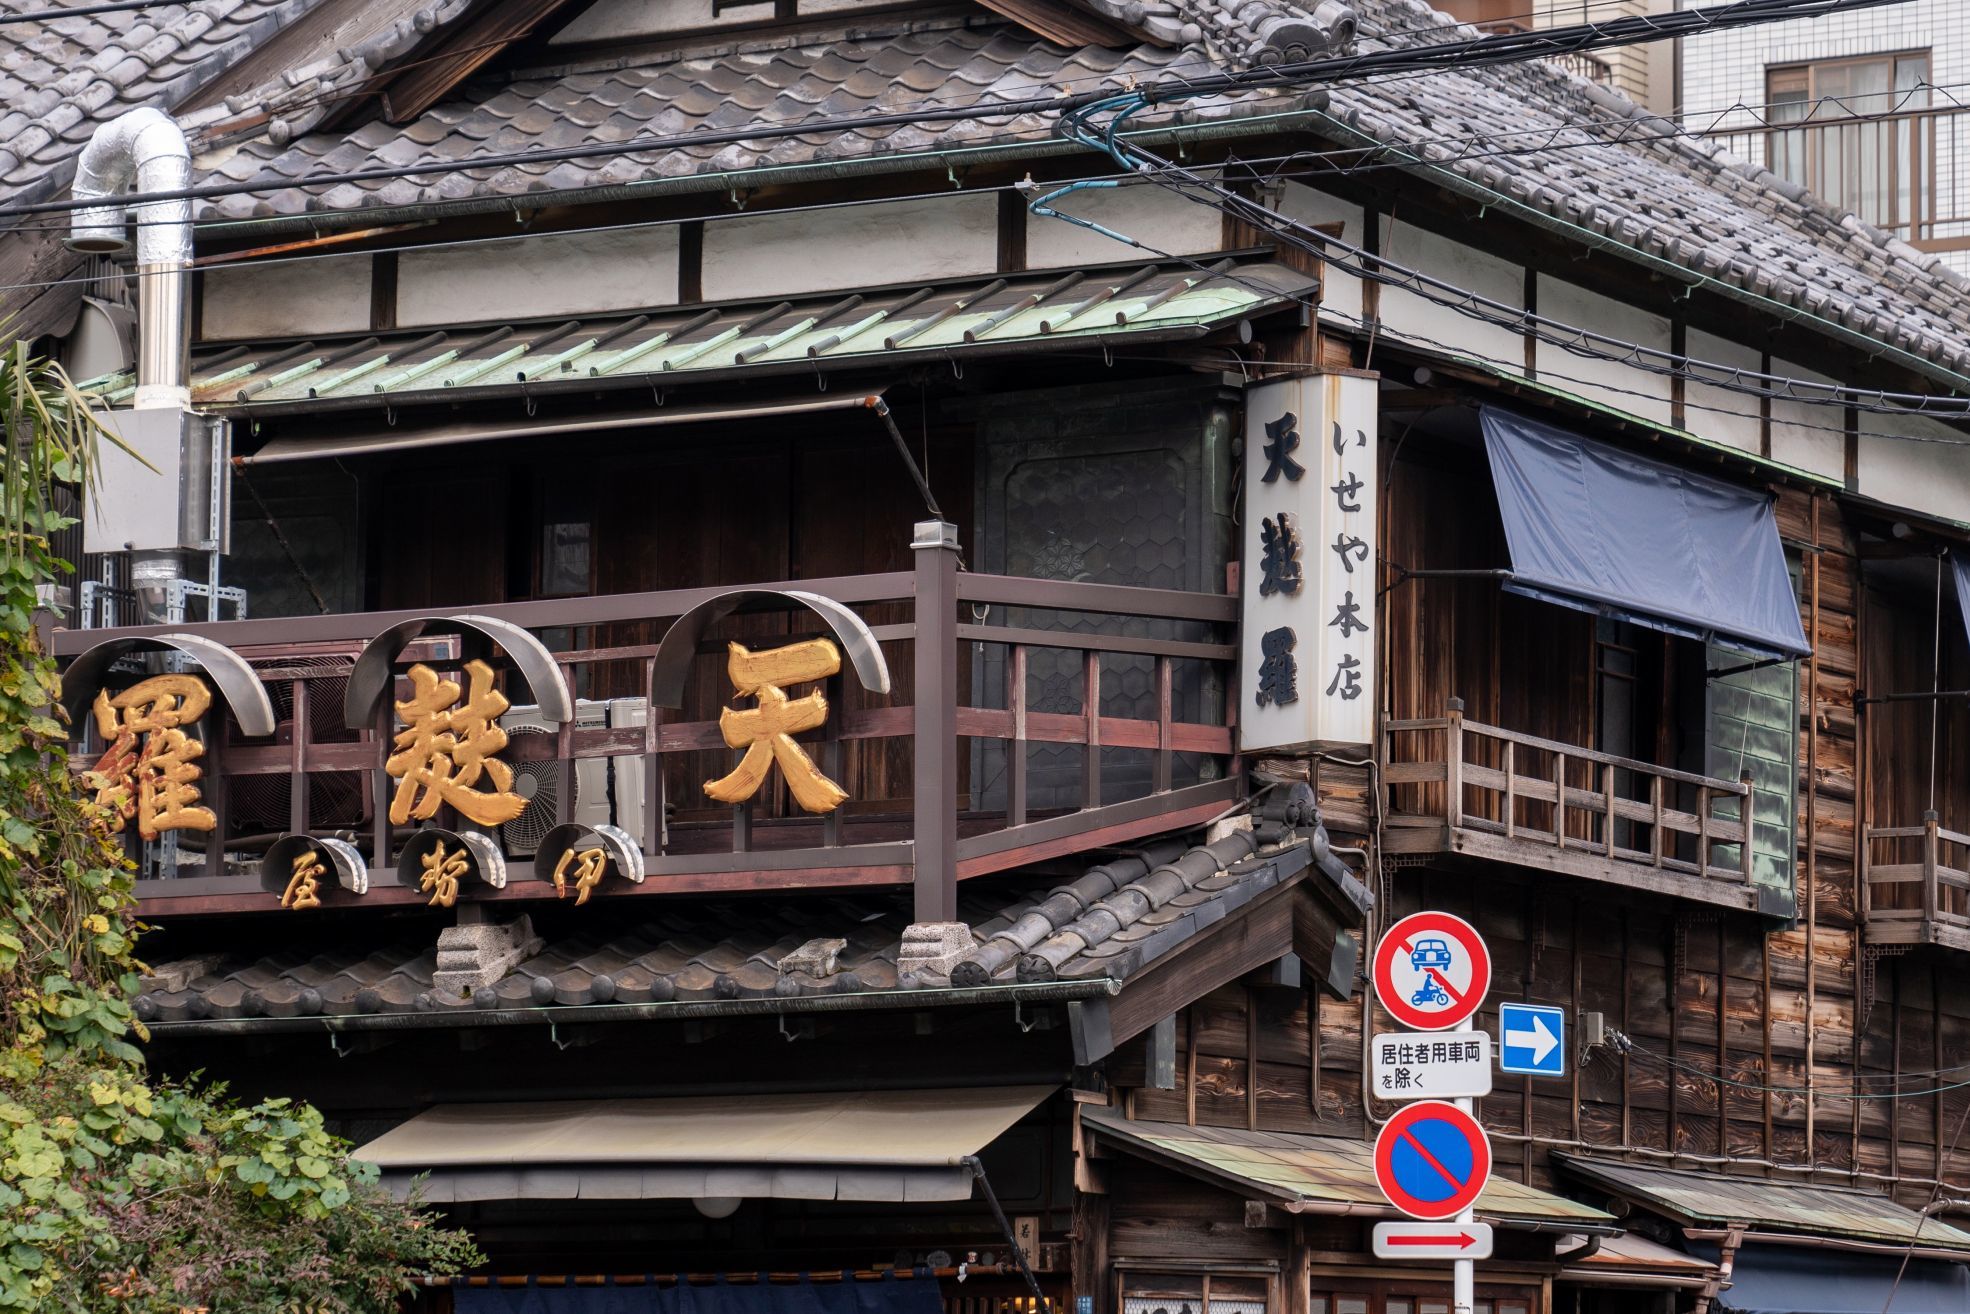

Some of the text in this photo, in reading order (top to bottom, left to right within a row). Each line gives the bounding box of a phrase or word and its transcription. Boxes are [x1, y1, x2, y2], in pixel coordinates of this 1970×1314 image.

[1326, 420, 1370, 700] いせや本店
[1381, 1041, 1480, 1065] 居住者用車両
[1382, 1067, 1424, 1089] を除く
